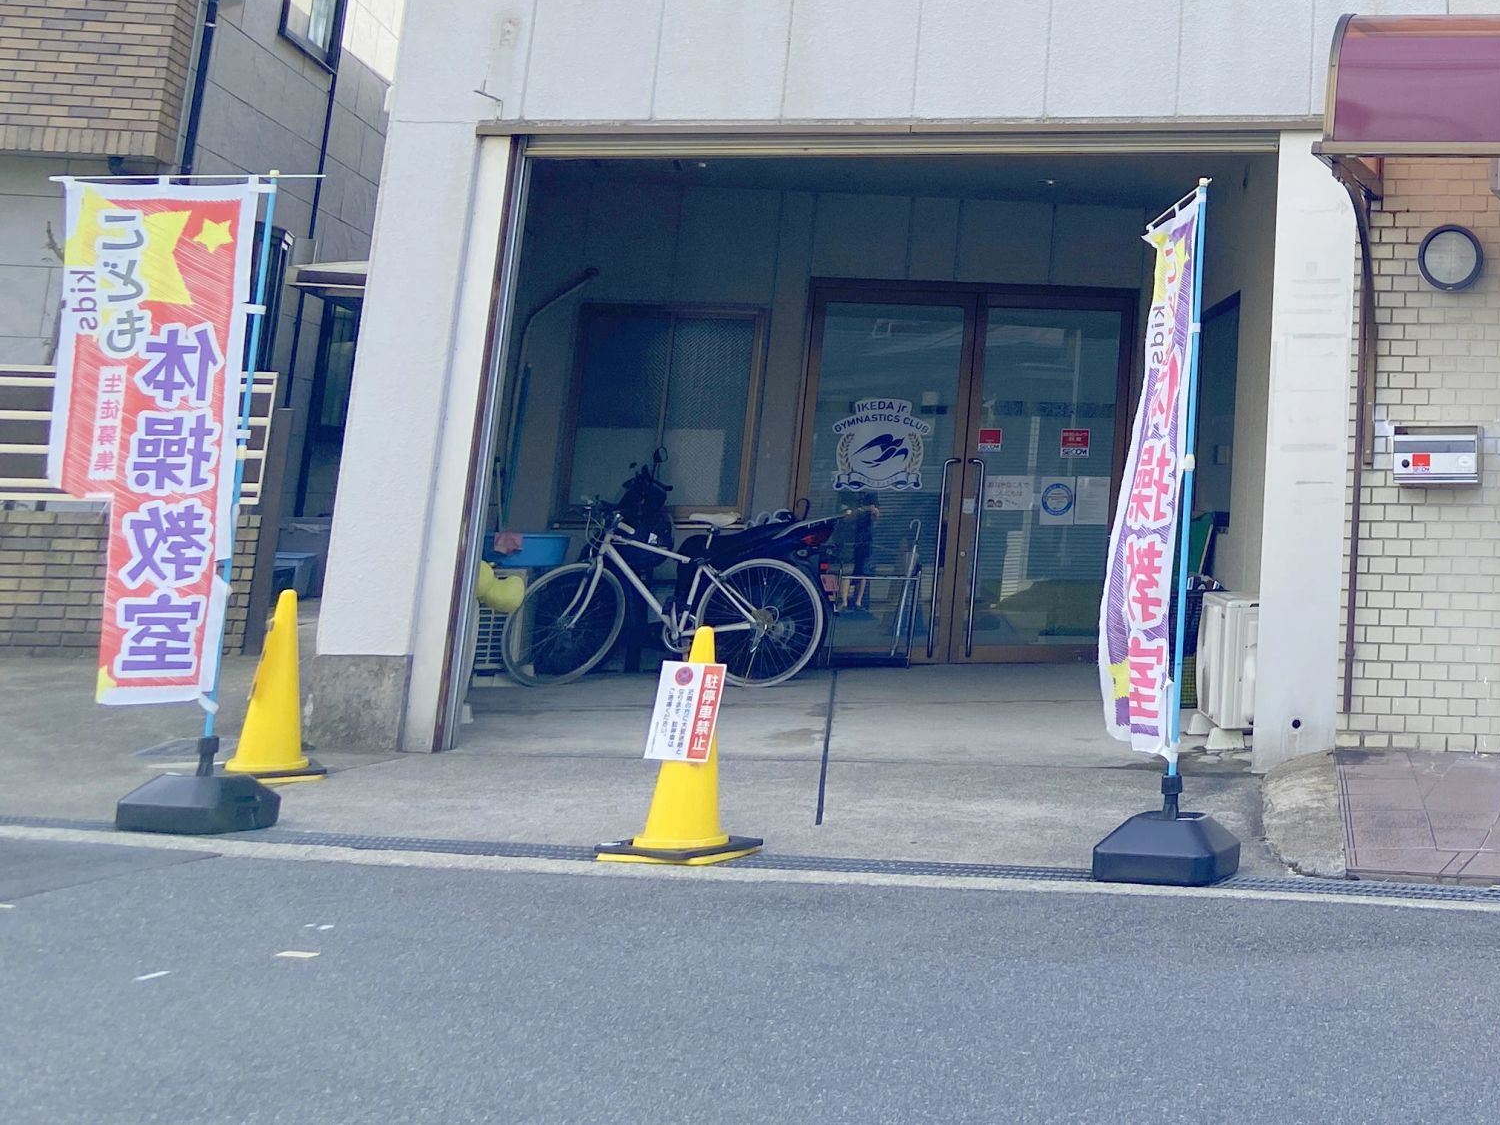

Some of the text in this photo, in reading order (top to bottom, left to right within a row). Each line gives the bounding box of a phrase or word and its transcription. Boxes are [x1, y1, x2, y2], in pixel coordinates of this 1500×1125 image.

[857, 400, 894, 412] IKEDA
[834, 413, 930, 434] GYMNASTICS CLUB
[692, 674, 719, 751] 駐停車禁止
